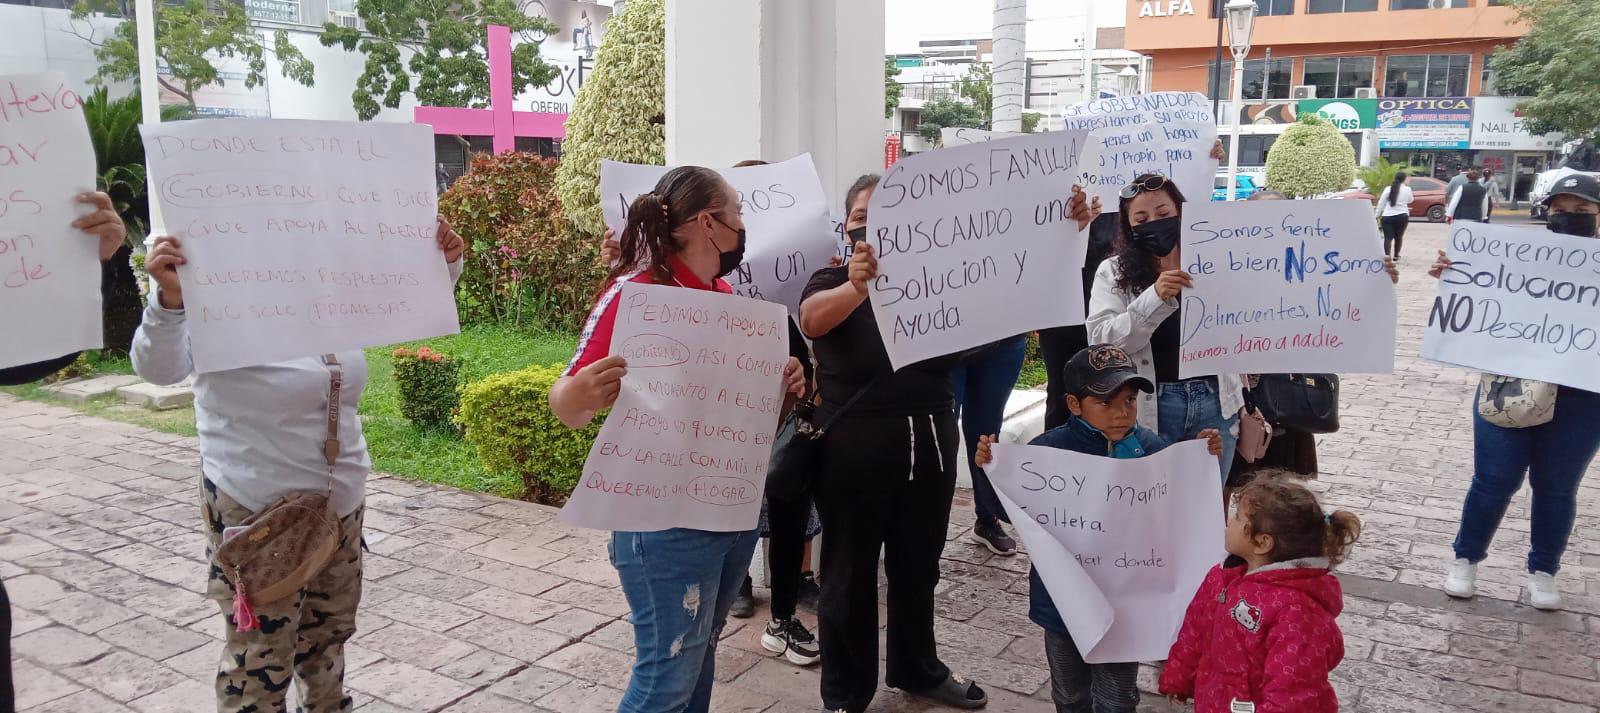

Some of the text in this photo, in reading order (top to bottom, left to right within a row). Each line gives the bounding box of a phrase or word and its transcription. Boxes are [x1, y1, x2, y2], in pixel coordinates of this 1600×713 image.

[1139, 0, 1195, 17] ALFA
[0, 82, 83, 122] ltera
[1379, 100, 1470, 109] OPTICA
[1481, 122, 1509, 133] NAIL
[153, 134, 268, 160] DONDE
[280, 136, 344, 154] ESTA
[881, 138, 1079, 209] SOMOS FAMILIA
[877, 207, 1012, 259] BUSCANDO
[1189, 214, 1331, 245] Somos Gente
[1188, 254, 1215, 275] de
[874, 255, 997, 307] Solucion
[1347, 303, 1361, 322] le
[1428, 293, 1474, 333] NO
[1182, 347, 1228, 364] hacemos
[1233, 333, 1272, 354] daño
[1275, 336, 1287, 350] a
[600, 442, 633, 458] EN
[634, 448, 654, 465] LA
[689, 451, 721, 470] CON
[586, 471, 668, 499] QUEREMOS
[693, 482, 751, 500] HOGAR
[1020, 461, 1086, 497] Soy
[1114, 550, 1166, 569] donde
